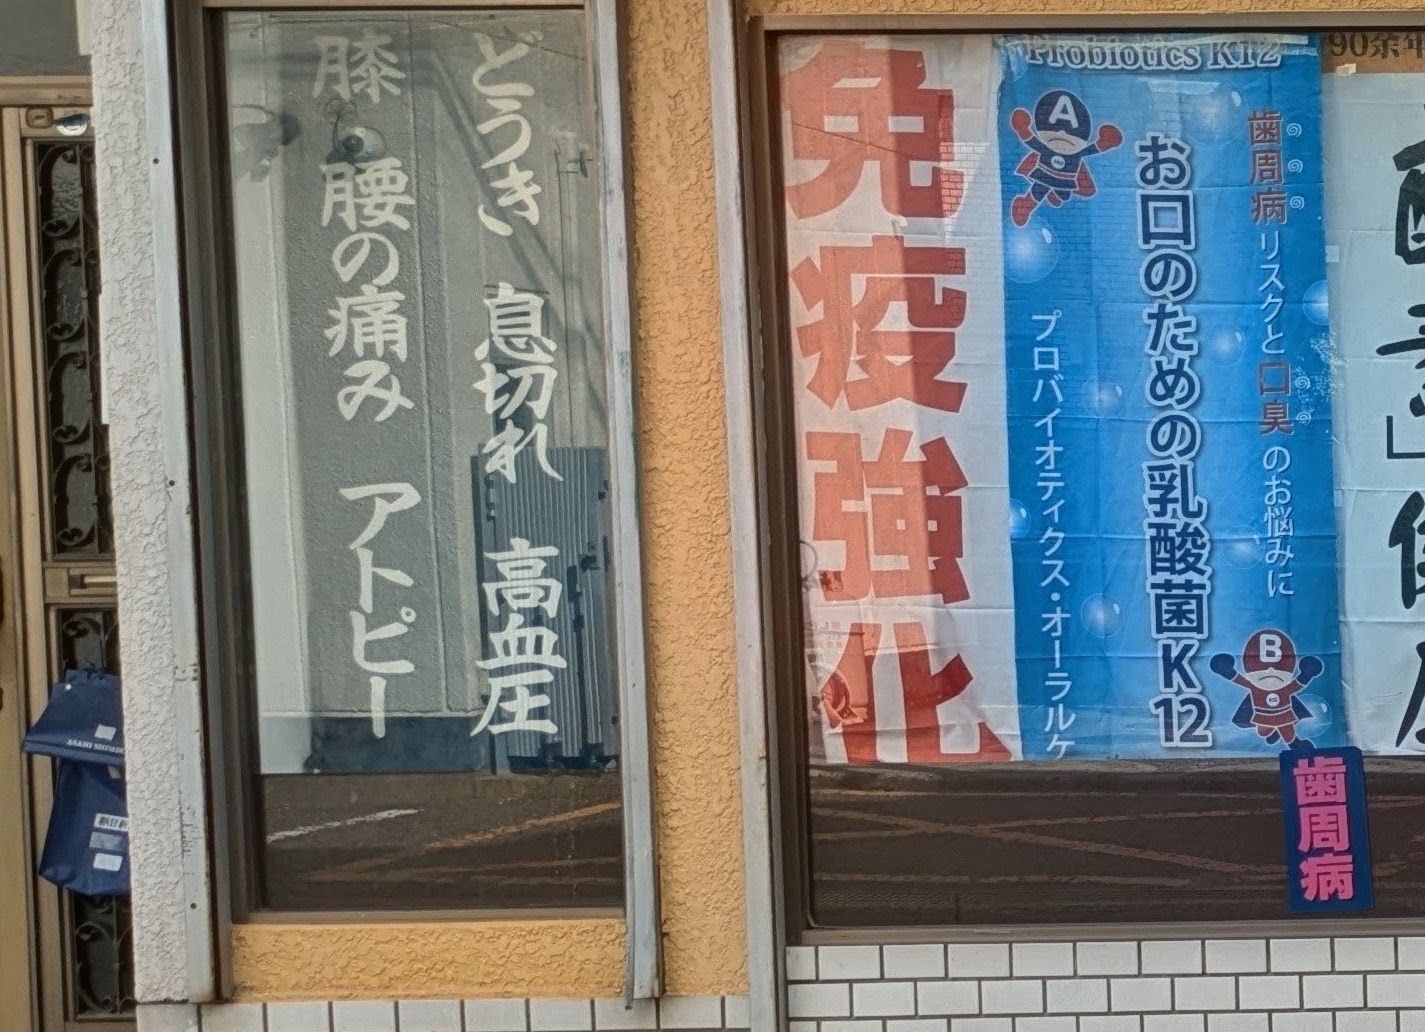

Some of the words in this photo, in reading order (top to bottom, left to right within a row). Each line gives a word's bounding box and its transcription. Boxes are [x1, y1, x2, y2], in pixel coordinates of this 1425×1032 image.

[470, 32, 544, 237] どうき
[1024, 32, 1202, 70] Probiotics
[320, 162, 417, 424] 腰の痛み
[474, 281, 564, 484] 息切れ
[785, 36, 1014, 764] 免疫強化
[1134, 132, 1215, 750] お口のための乳酸菌K12
[338, 482, 422, 741] アトピー
[469, 537, 568, 738] 高血圧
[1291, 757, 1356, 904] 歯周病
